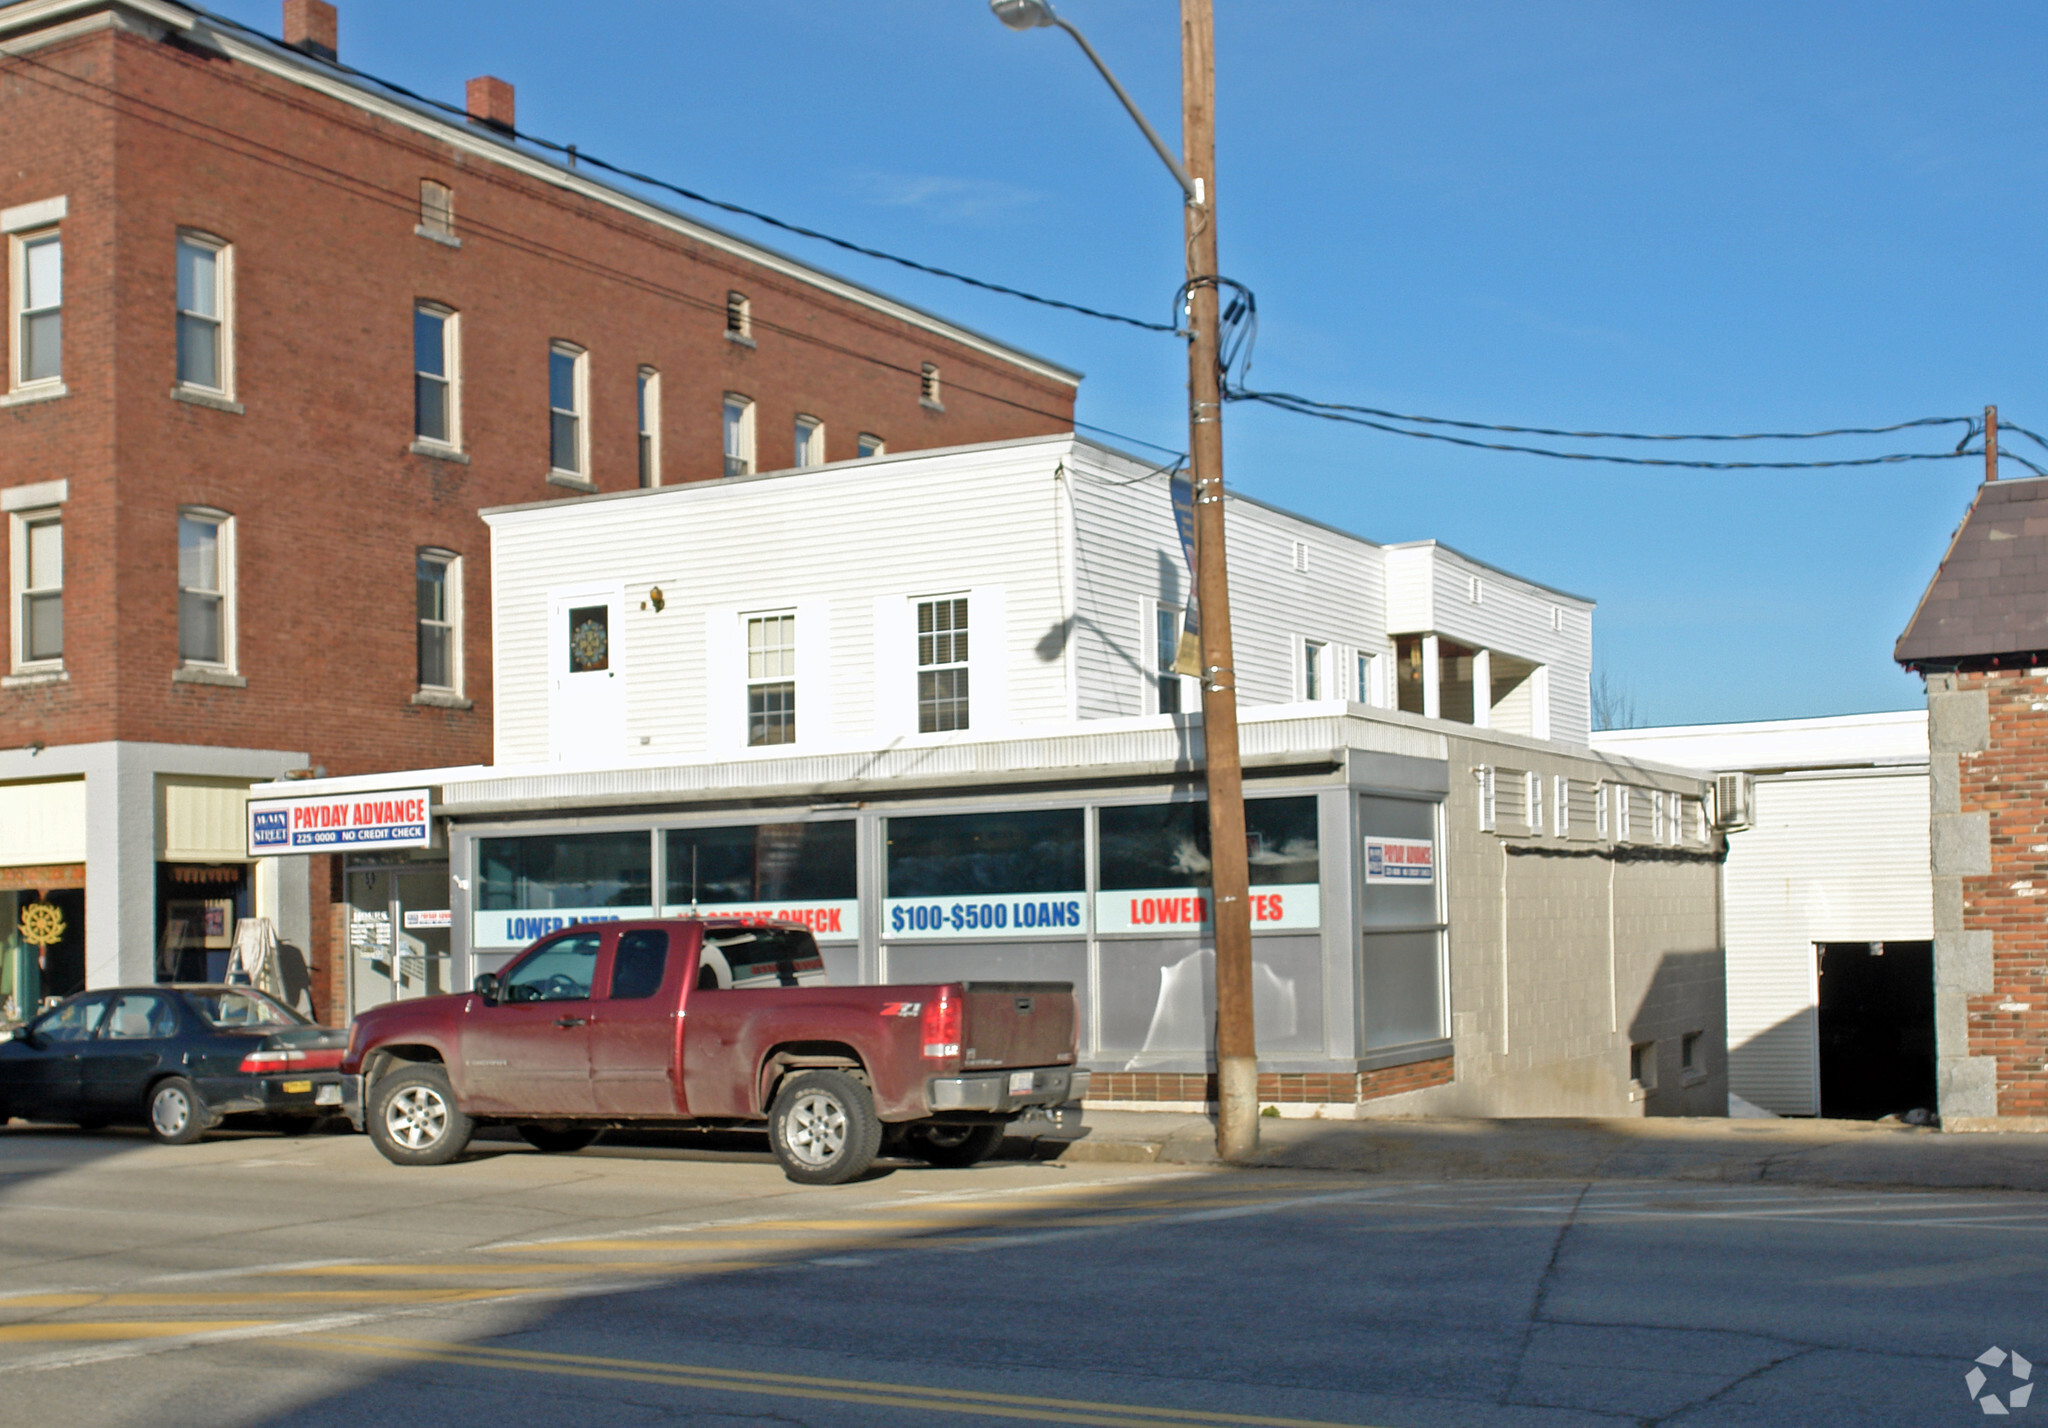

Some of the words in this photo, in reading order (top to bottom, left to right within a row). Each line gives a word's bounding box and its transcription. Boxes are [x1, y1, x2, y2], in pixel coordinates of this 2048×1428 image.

[255, 812, 285, 827] MAIN
[294, 803, 348, 829] PAYDAY
[353, 798, 424, 826] ADVANCE
[255, 828, 286, 843] STREET
[342, 830, 354, 841] NO
[358, 828, 388, 840] CREDIT
[391, 825, 421, 838] CHECK
[891, 902, 1008, 932] $100-$500
[1013, 901, 1080, 927] LOANS
[1131, 897, 1207, 924] LOWER
[1248, 894, 1283, 921] TES
[506, 917, 563, 940] LOWER
[880, 1002, 921, 1015] Z71
